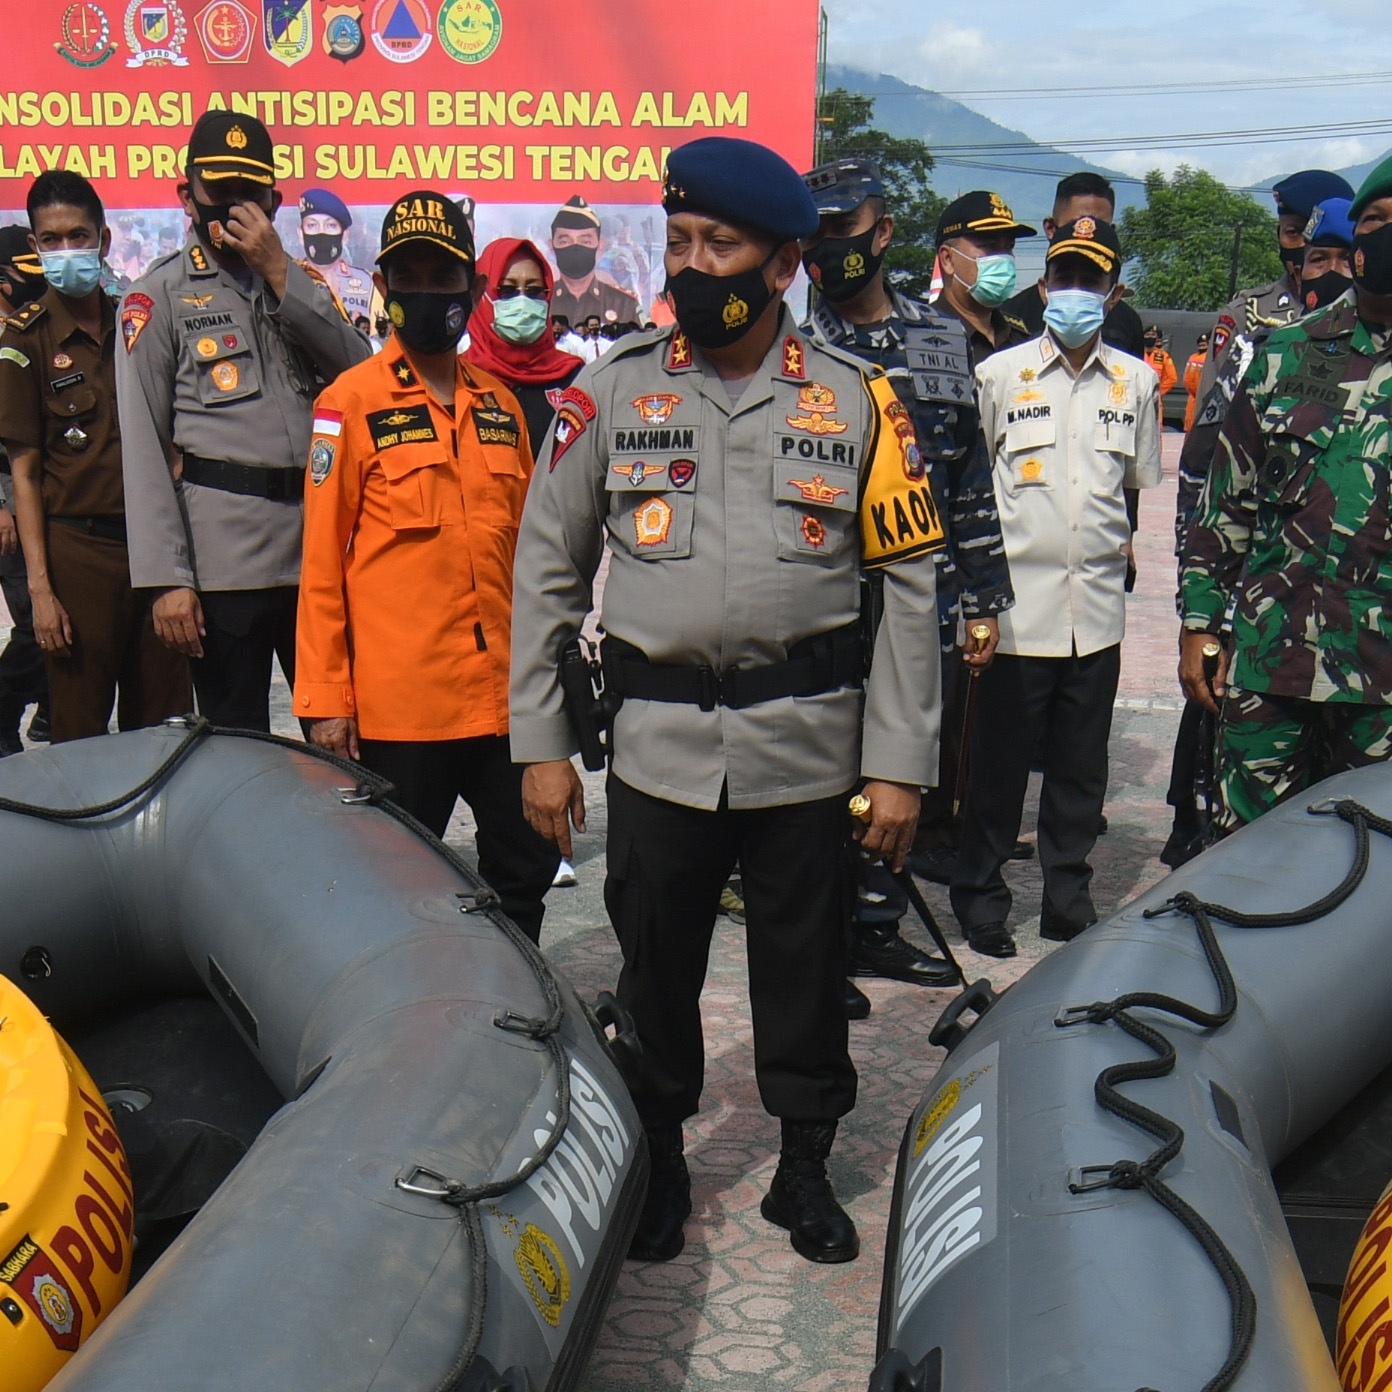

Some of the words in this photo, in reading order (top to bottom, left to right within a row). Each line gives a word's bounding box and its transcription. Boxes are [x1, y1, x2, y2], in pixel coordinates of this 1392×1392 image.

[457, 2, 482, 12] SAR
[144, 50, 170, 59] DPRD
[391, 41, 412, 49] BPBD
[206, 90, 416, 127] ANTISIPASI
[428, 90, 622, 127] BENCANA
[630, 91, 749, 127] ALAM
[127, 144, 305, 179] PRSI
[314, 143, 514, 180] SULAWESI
[395, 198, 446, 222] SAR
[386, 218, 457, 242] NASIONAL
[844, 268, 866, 279] POLRI
[342, 297, 368, 308] POLRI
[184, 313, 234, 332] NORMAN
[725, 317, 748, 330] POLRI
[919, 353, 940, 367] TNI
[945, 356, 959, 370] AL
[1284, 382, 1340, 403] FARID
[1007, 405, 1051, 424] M.NADIR
[1098, 409, 1121, 424] POL
[1122, 413, 1135, 427] PP
[478, 427, 518, 447] BASARNAS
[615, 429, 694, 451] RAKHMAN
[781, 436, 854, 466] POLRI
[517, 1058, 630, 1269] POLISI
[49, 1086, 134, 1319] POLISI
[896, 1102, 984, 1332] POLISI
